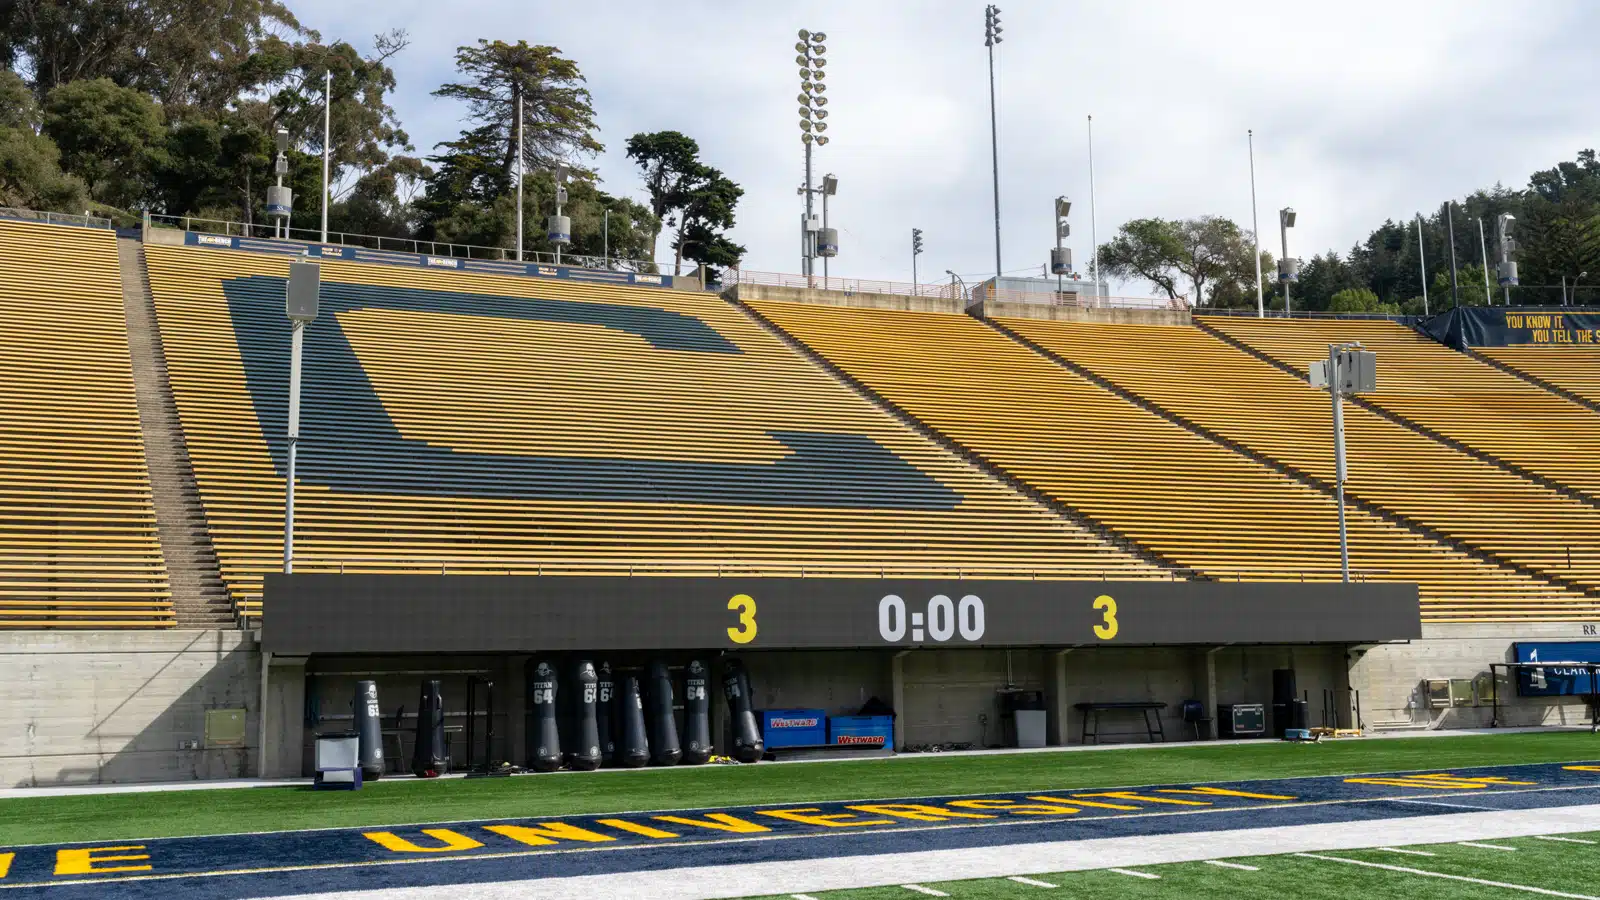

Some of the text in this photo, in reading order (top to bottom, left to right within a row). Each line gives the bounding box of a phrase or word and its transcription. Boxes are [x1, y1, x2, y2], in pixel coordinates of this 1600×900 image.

[1506, 315, 1565, 329] YOU KNOW IT.
[1532, 329, 1549, 343] YOU
[1552, 329, 1573, 343] TELL
[1576, 329, 1593, 343] THE
[727, 594, 758, 644] 3
[878, 594, 986, 642] 0:00
[1092, 595, 1119, 640] 3
[1583, 624, 1596, 635] RR
[1554, 667, 1600, 675] CLAR
[533, 681, 553, 689] TITAN
[533, 689, 554, 704] 64
[686, 686, 706, 701] 64
[770, 718, 818, 728] WESTWARD
[837, 736, 885, 744] WESTWARD
[362, 787, 1294, 853] UNIVERSITY
